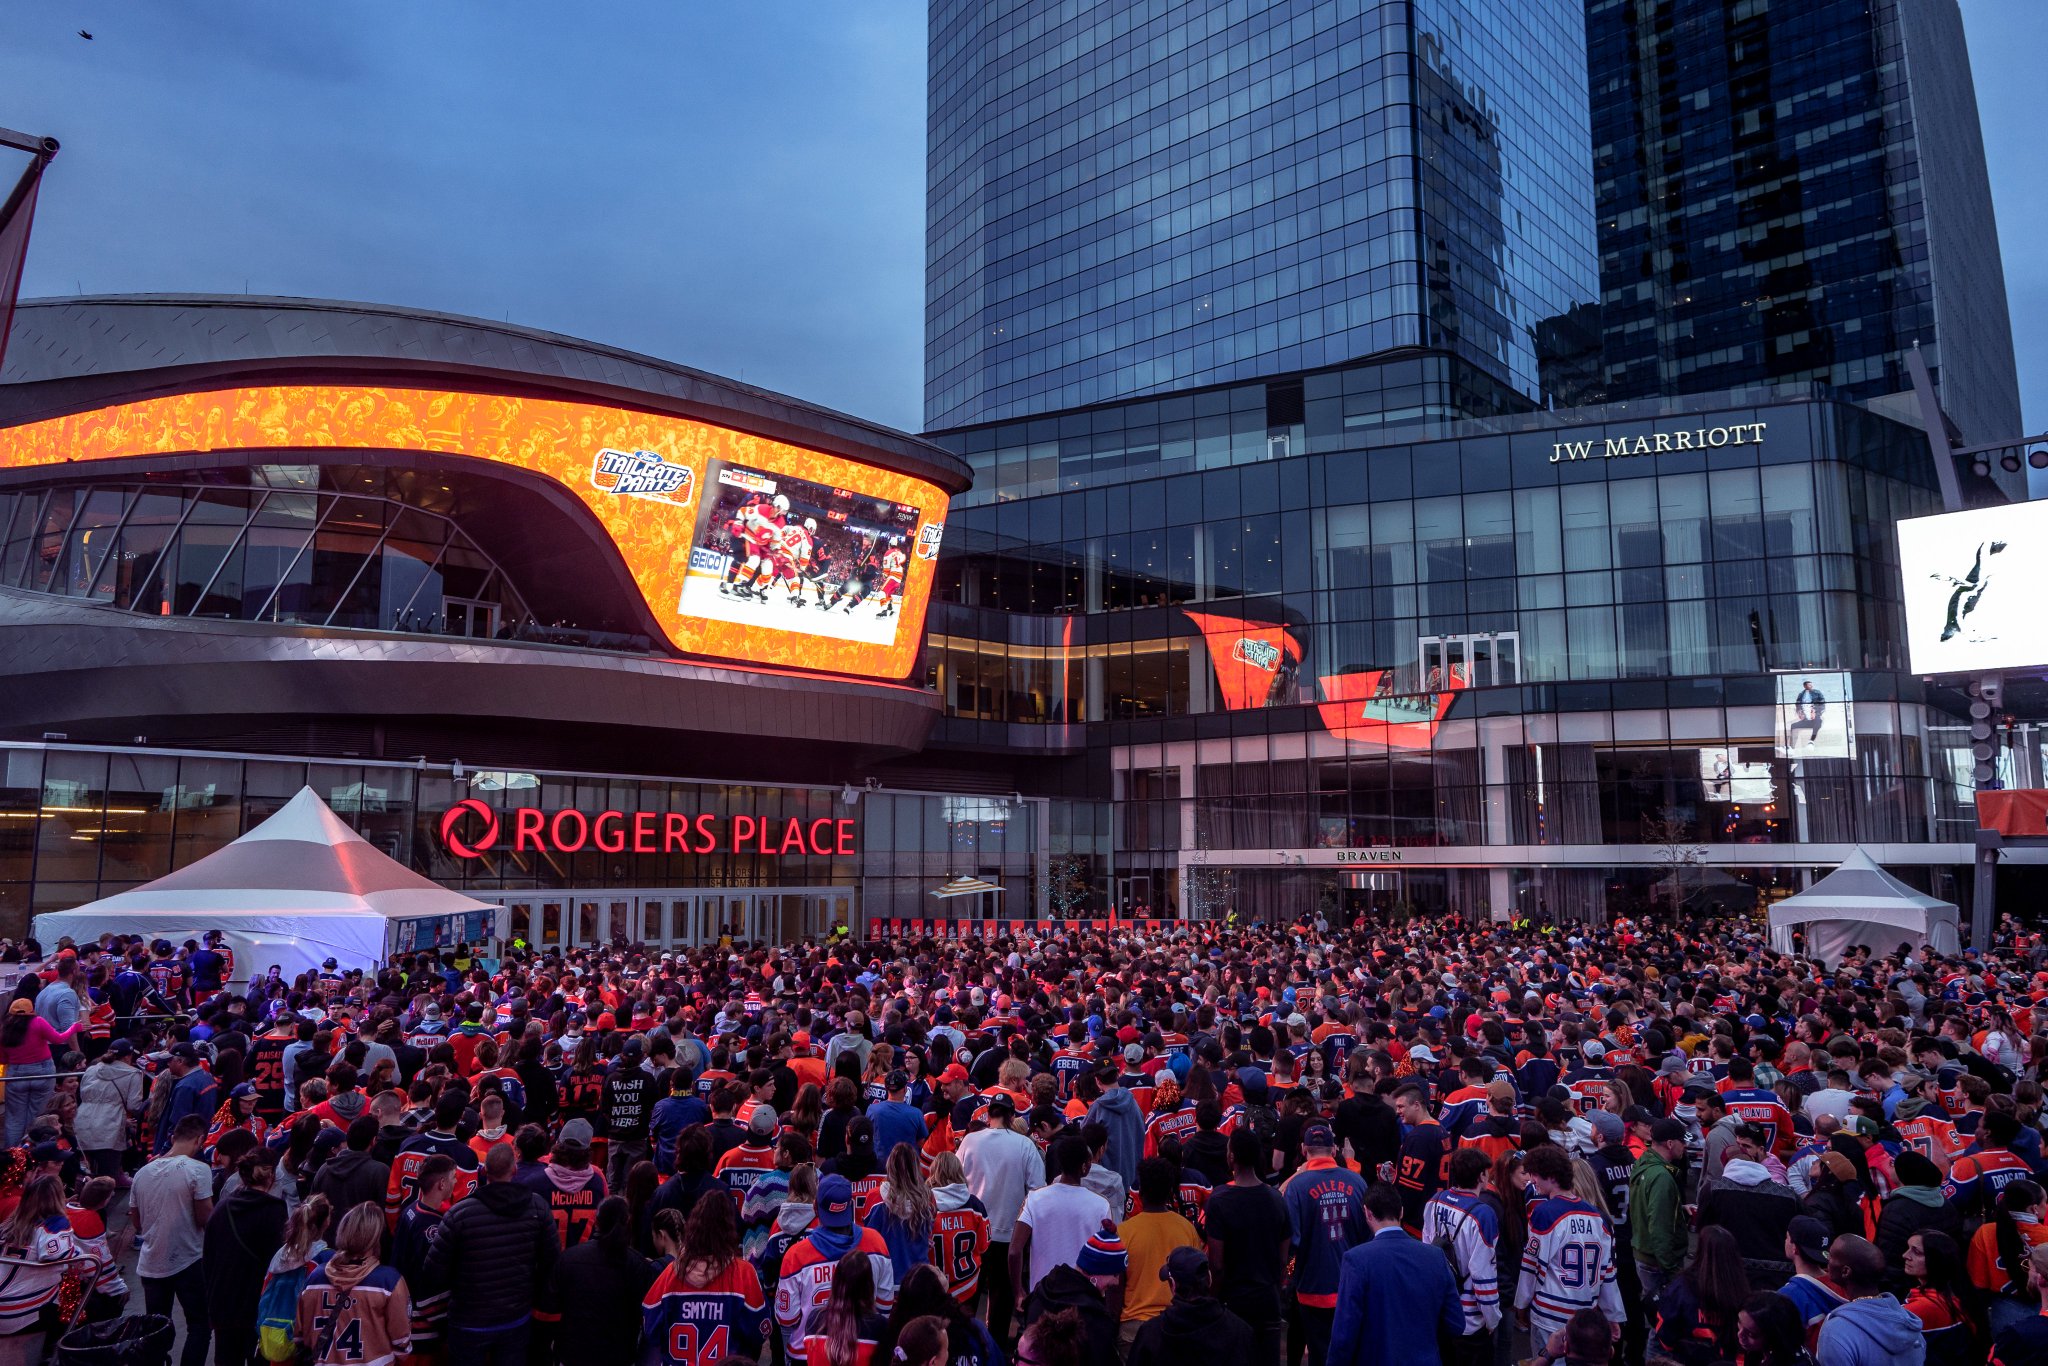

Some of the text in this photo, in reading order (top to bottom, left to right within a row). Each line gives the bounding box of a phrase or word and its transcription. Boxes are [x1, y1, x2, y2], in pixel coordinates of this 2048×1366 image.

[1549, 422, 1767, 462] JW MARRIOTT
[600, 452, 690, 482] TAILGATE
[611, 473, 684, 493] PARTY
[827, 510, 848, 522] CLAP!
[691, 550, 722, 571] GEICO
[515, 807, 856, 856] ROGERS PLACE
[1337, 851, 1402, 862] BRAVEN
[254, 1061, 284, 1090] 29
[612, 1079, 644, 1091] WISH
[614, 1092, 640, 1104] YOU
[610, 1104, 642, 1116] WERE
[610, 1116, 640, 1128] HERE
[1159, 1114, 1195, 1133] McDAVID
[1901, 1136, 1933, 1165] 7
[1401, 1154, 1426, 1179] 97
[551, 1190, 593, 1207] McDAVID
[1308, 1180, 1354, 1201] OILERS
[941, 1216, 966, 1231] NEAL
[46, 1235, 74, 1255] 97
[932, 1230, 977, 1281] 18
[1559, 1241, 1603, 1290] 97
[681, 1301, 725, 1321] SMYTH
[313, 1315, 363, 1361] 74
[668, 1322, 731, 1366] 94
